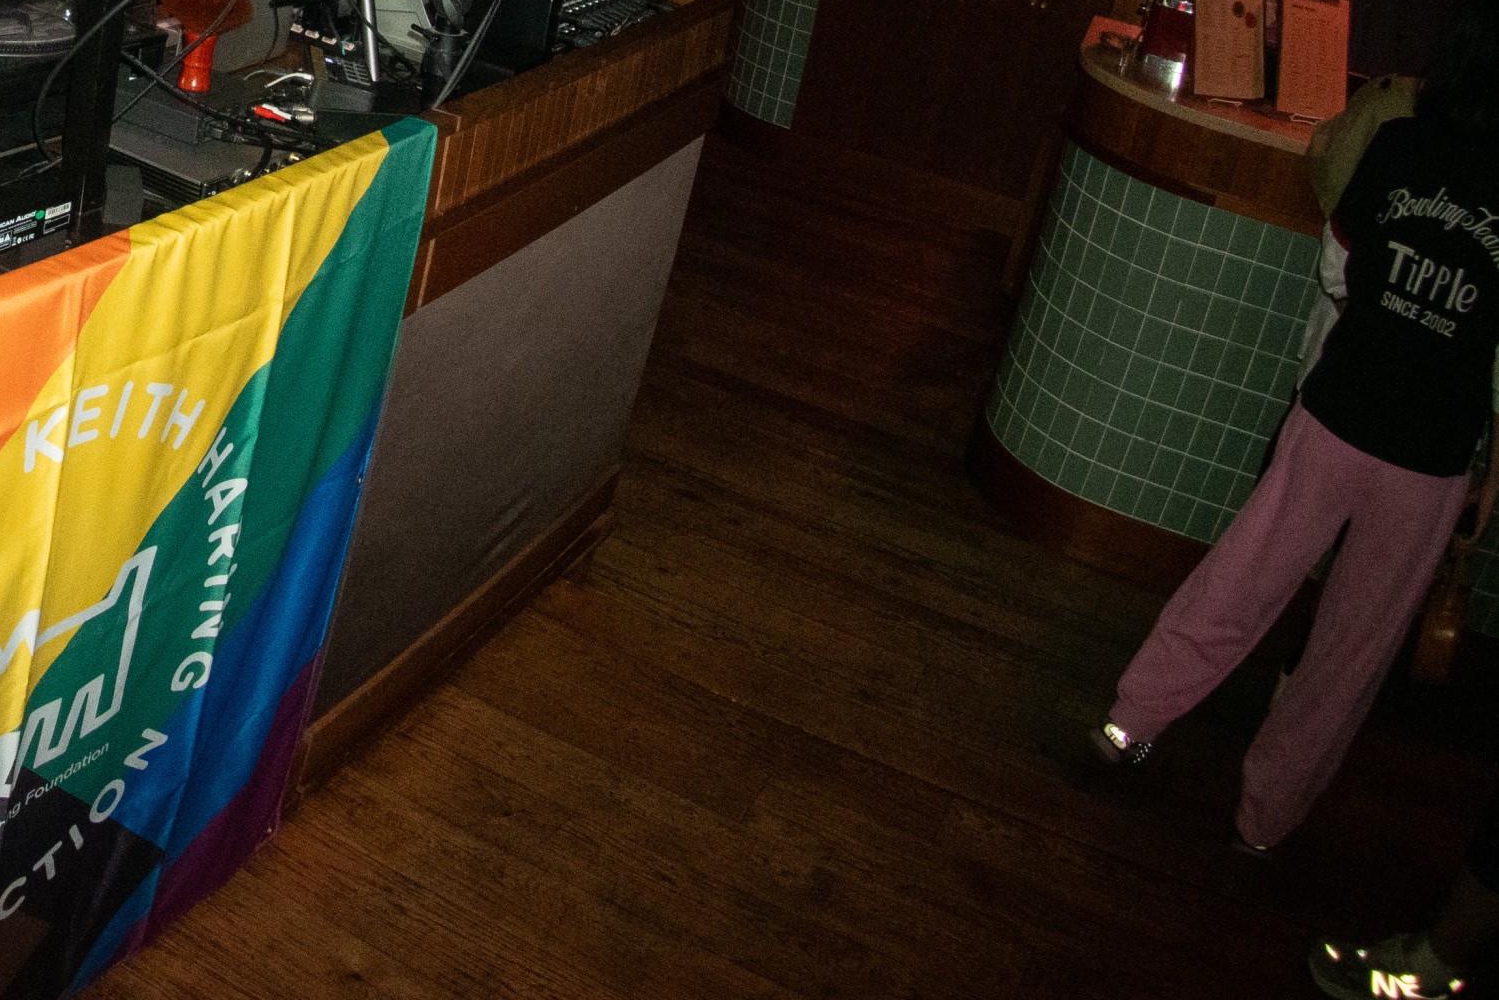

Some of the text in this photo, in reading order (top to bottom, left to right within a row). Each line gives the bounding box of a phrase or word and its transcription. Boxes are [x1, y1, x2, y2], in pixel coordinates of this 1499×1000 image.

[1376, 187, 1469, 230] Bowling
[1388, 240, 1478, 312] Tipple
[1380, 291, 1457, 338] SINCE 2002
[23, 383, 205, 473] KEITH
[171, 427, 249, 692] HARING
[25, 742, 110, 806] Foundation
